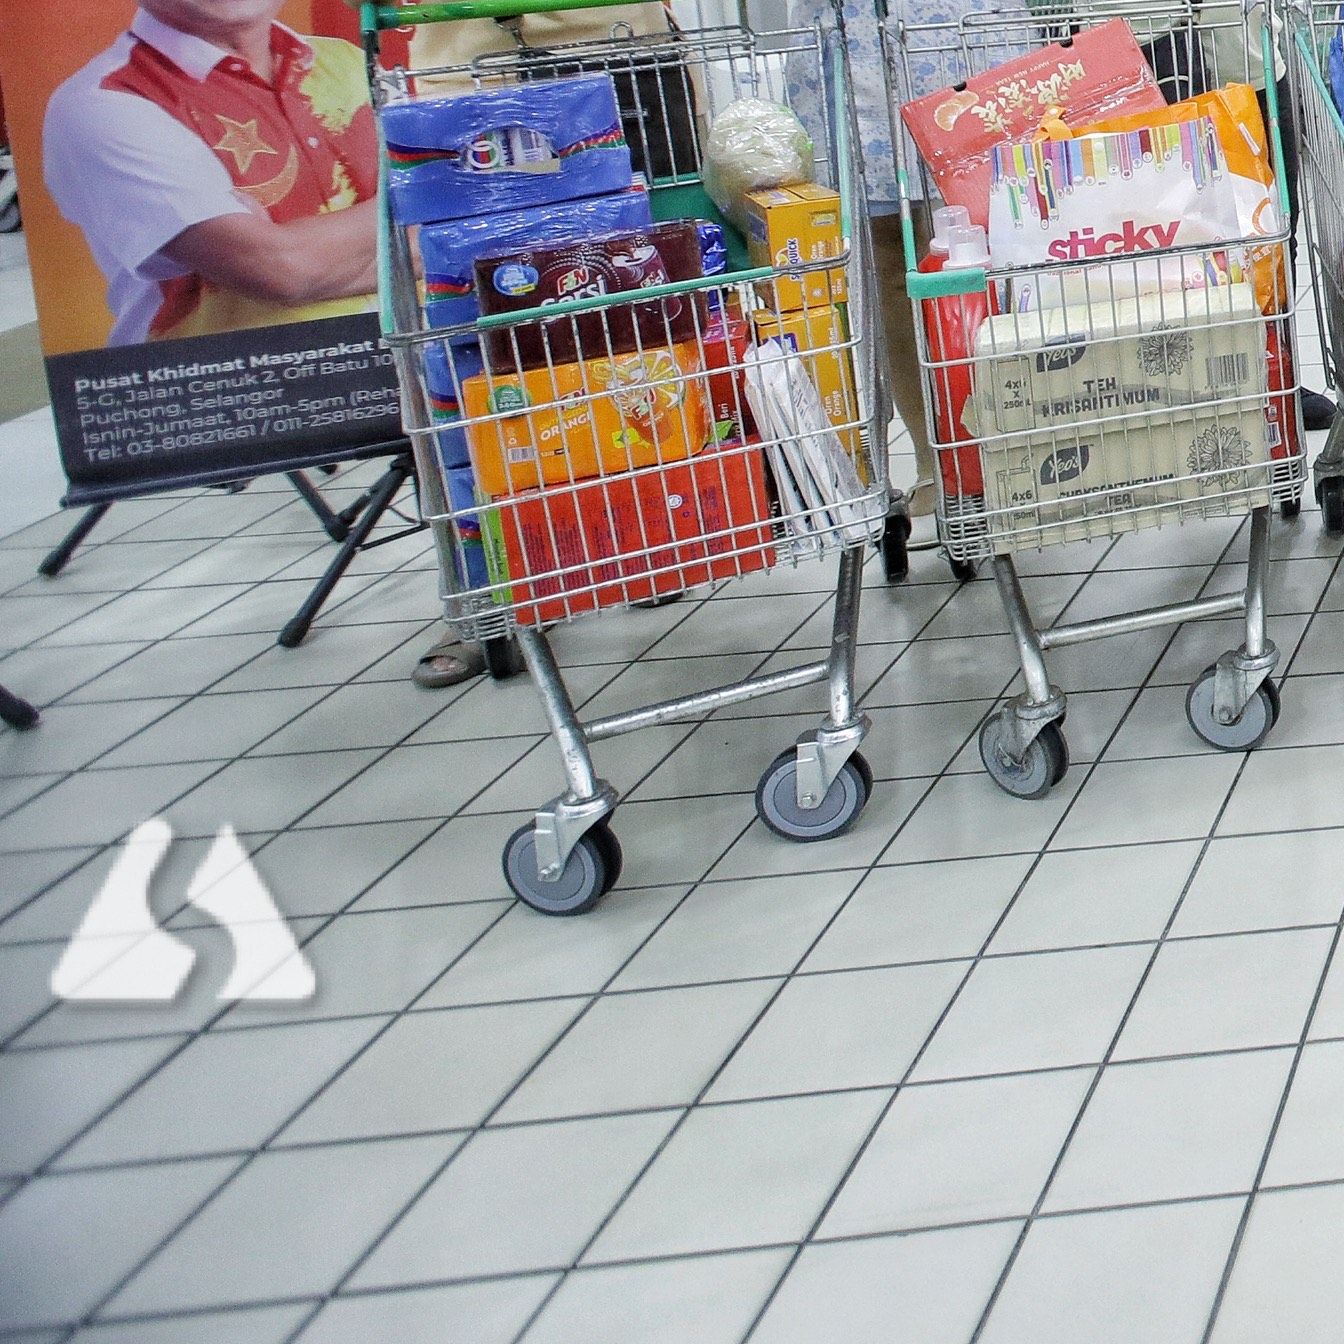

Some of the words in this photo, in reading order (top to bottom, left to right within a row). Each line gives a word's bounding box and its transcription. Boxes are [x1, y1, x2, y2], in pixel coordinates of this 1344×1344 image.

[1045, 219, 1181, 263] sticky
[557, 267, 589, 296] F&N
[75, 372, 144, 393] Pusat
[147, 357, 246, 383] Khidmat
[249, 340, 375, 368] Masyarakat
[125, 385, 184, 403] Jalan
[188, 373, 259, 394] Cenuk
[283, 363, 316, 380] Off
[320, 358, 369, 375] Batu
[190, 388, 285, 411] Selangor
[1083, 377, 1117, 394] TEH
[232, 395, 346, 422] 10am-5pm
[83, 445, 123, 462] Tel:
[127, 424, 257, 456] 03-80821661
[260, 419, 271, 436] /
[541, 412, 591, 442] ORANG
[1049, 455, 1080, 478] Yeo's
[1011, 489, 1033, 502] 4x6
